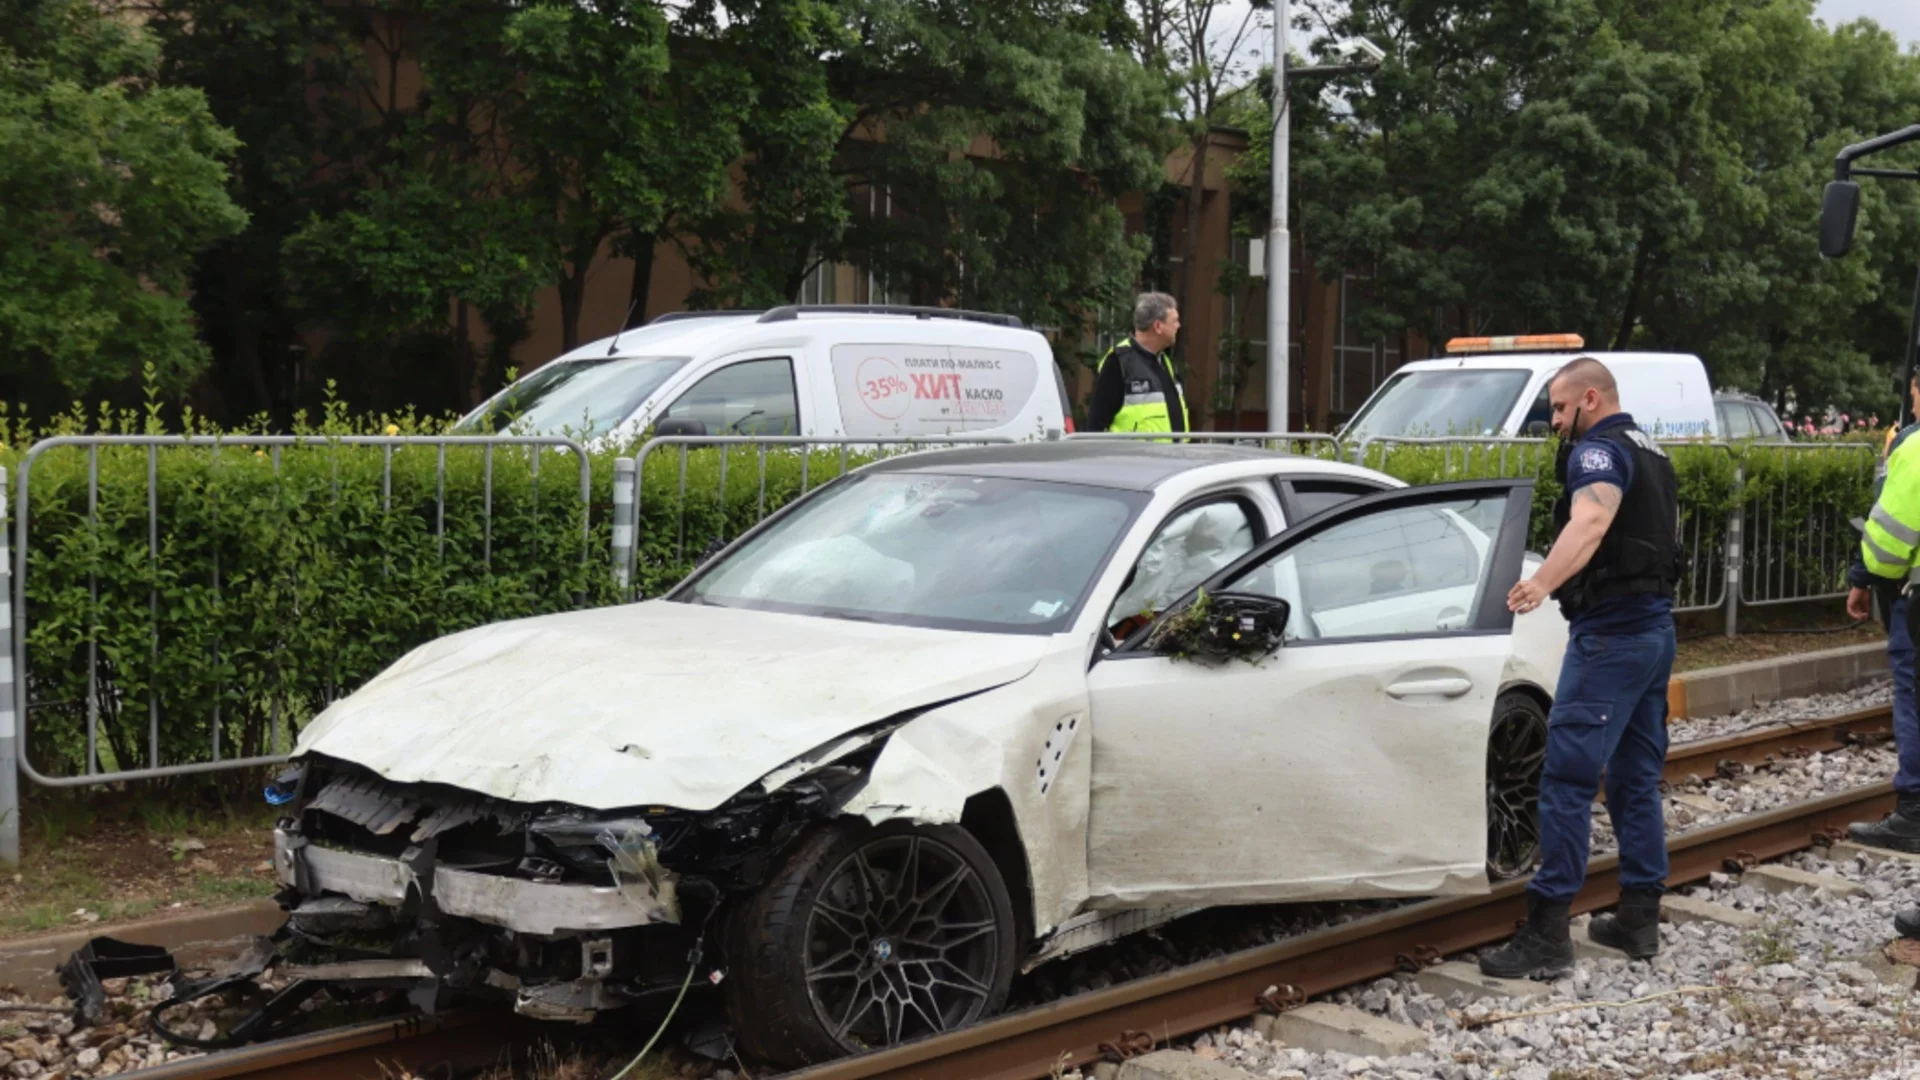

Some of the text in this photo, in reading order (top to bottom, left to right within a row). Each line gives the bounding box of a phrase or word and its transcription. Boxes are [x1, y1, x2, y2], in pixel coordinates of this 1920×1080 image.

[863, 375, 908, 400] -35%
[910, 373, 962, 400] ХИТ
[965, 388, 1003, 400] КАСКО
